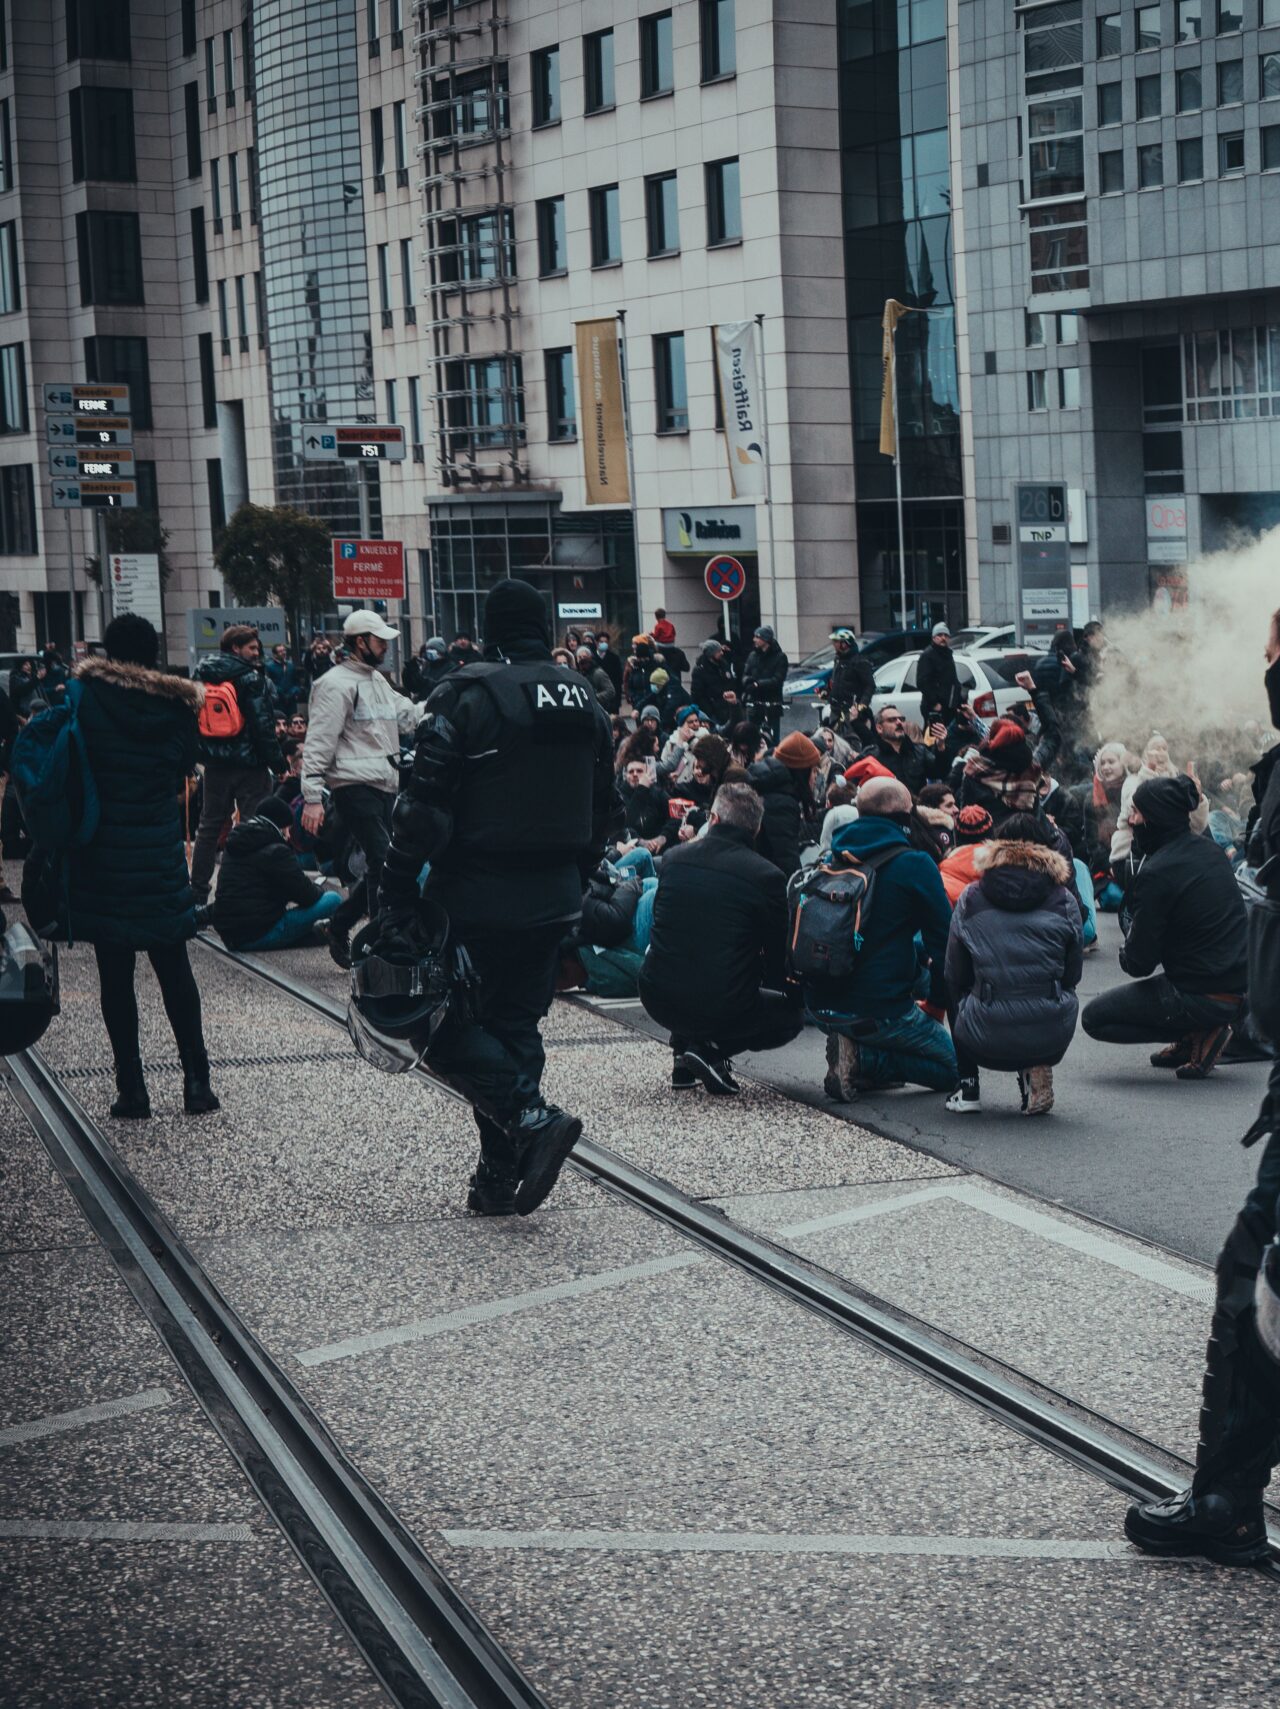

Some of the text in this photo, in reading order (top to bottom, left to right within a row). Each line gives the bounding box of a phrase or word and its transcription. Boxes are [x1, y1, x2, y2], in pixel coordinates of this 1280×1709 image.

[360, 444, 379, 457] 751
[359, 546, 398, 555] KNUEDLER
[537, 684, 558, 708] A
